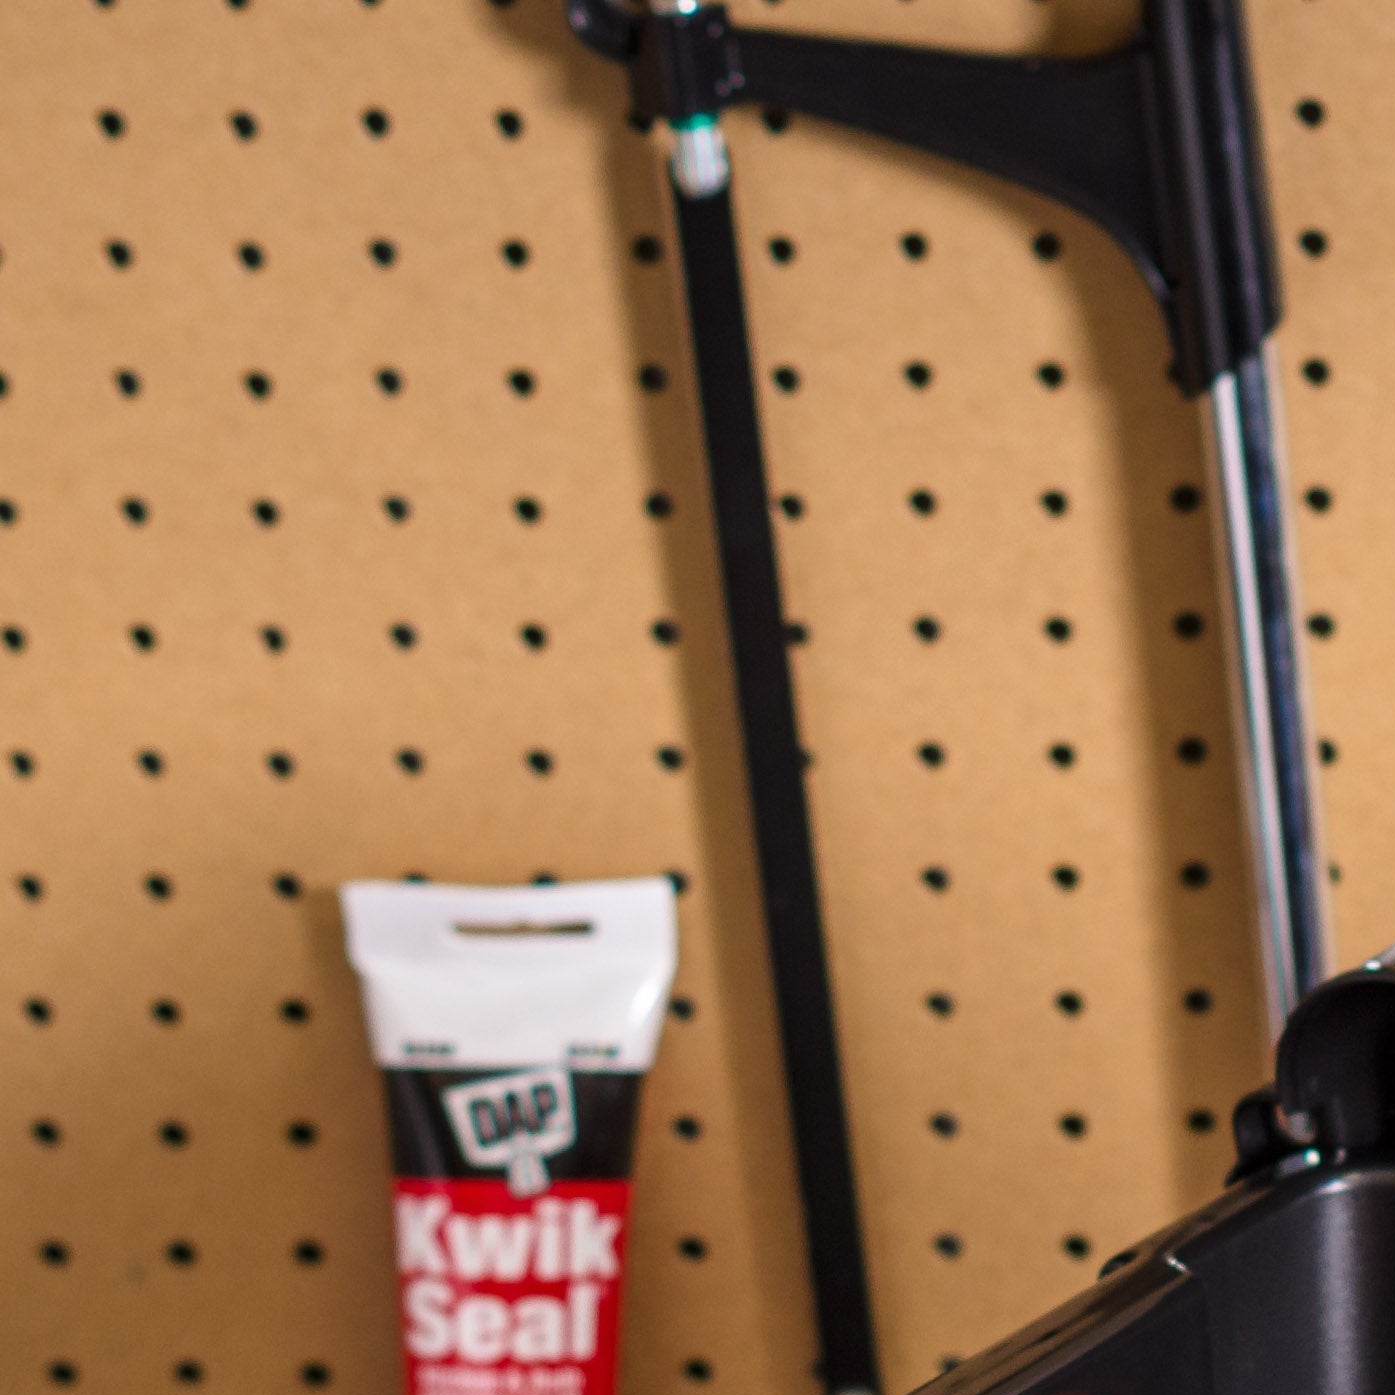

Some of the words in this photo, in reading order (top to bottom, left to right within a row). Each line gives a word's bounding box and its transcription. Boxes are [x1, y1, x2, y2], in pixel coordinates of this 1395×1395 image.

[470, 1082, 558, 1148] DAP
[396, 1193, 621, 1282] Kwik
[404, 1278, 598, 1364] Seal
